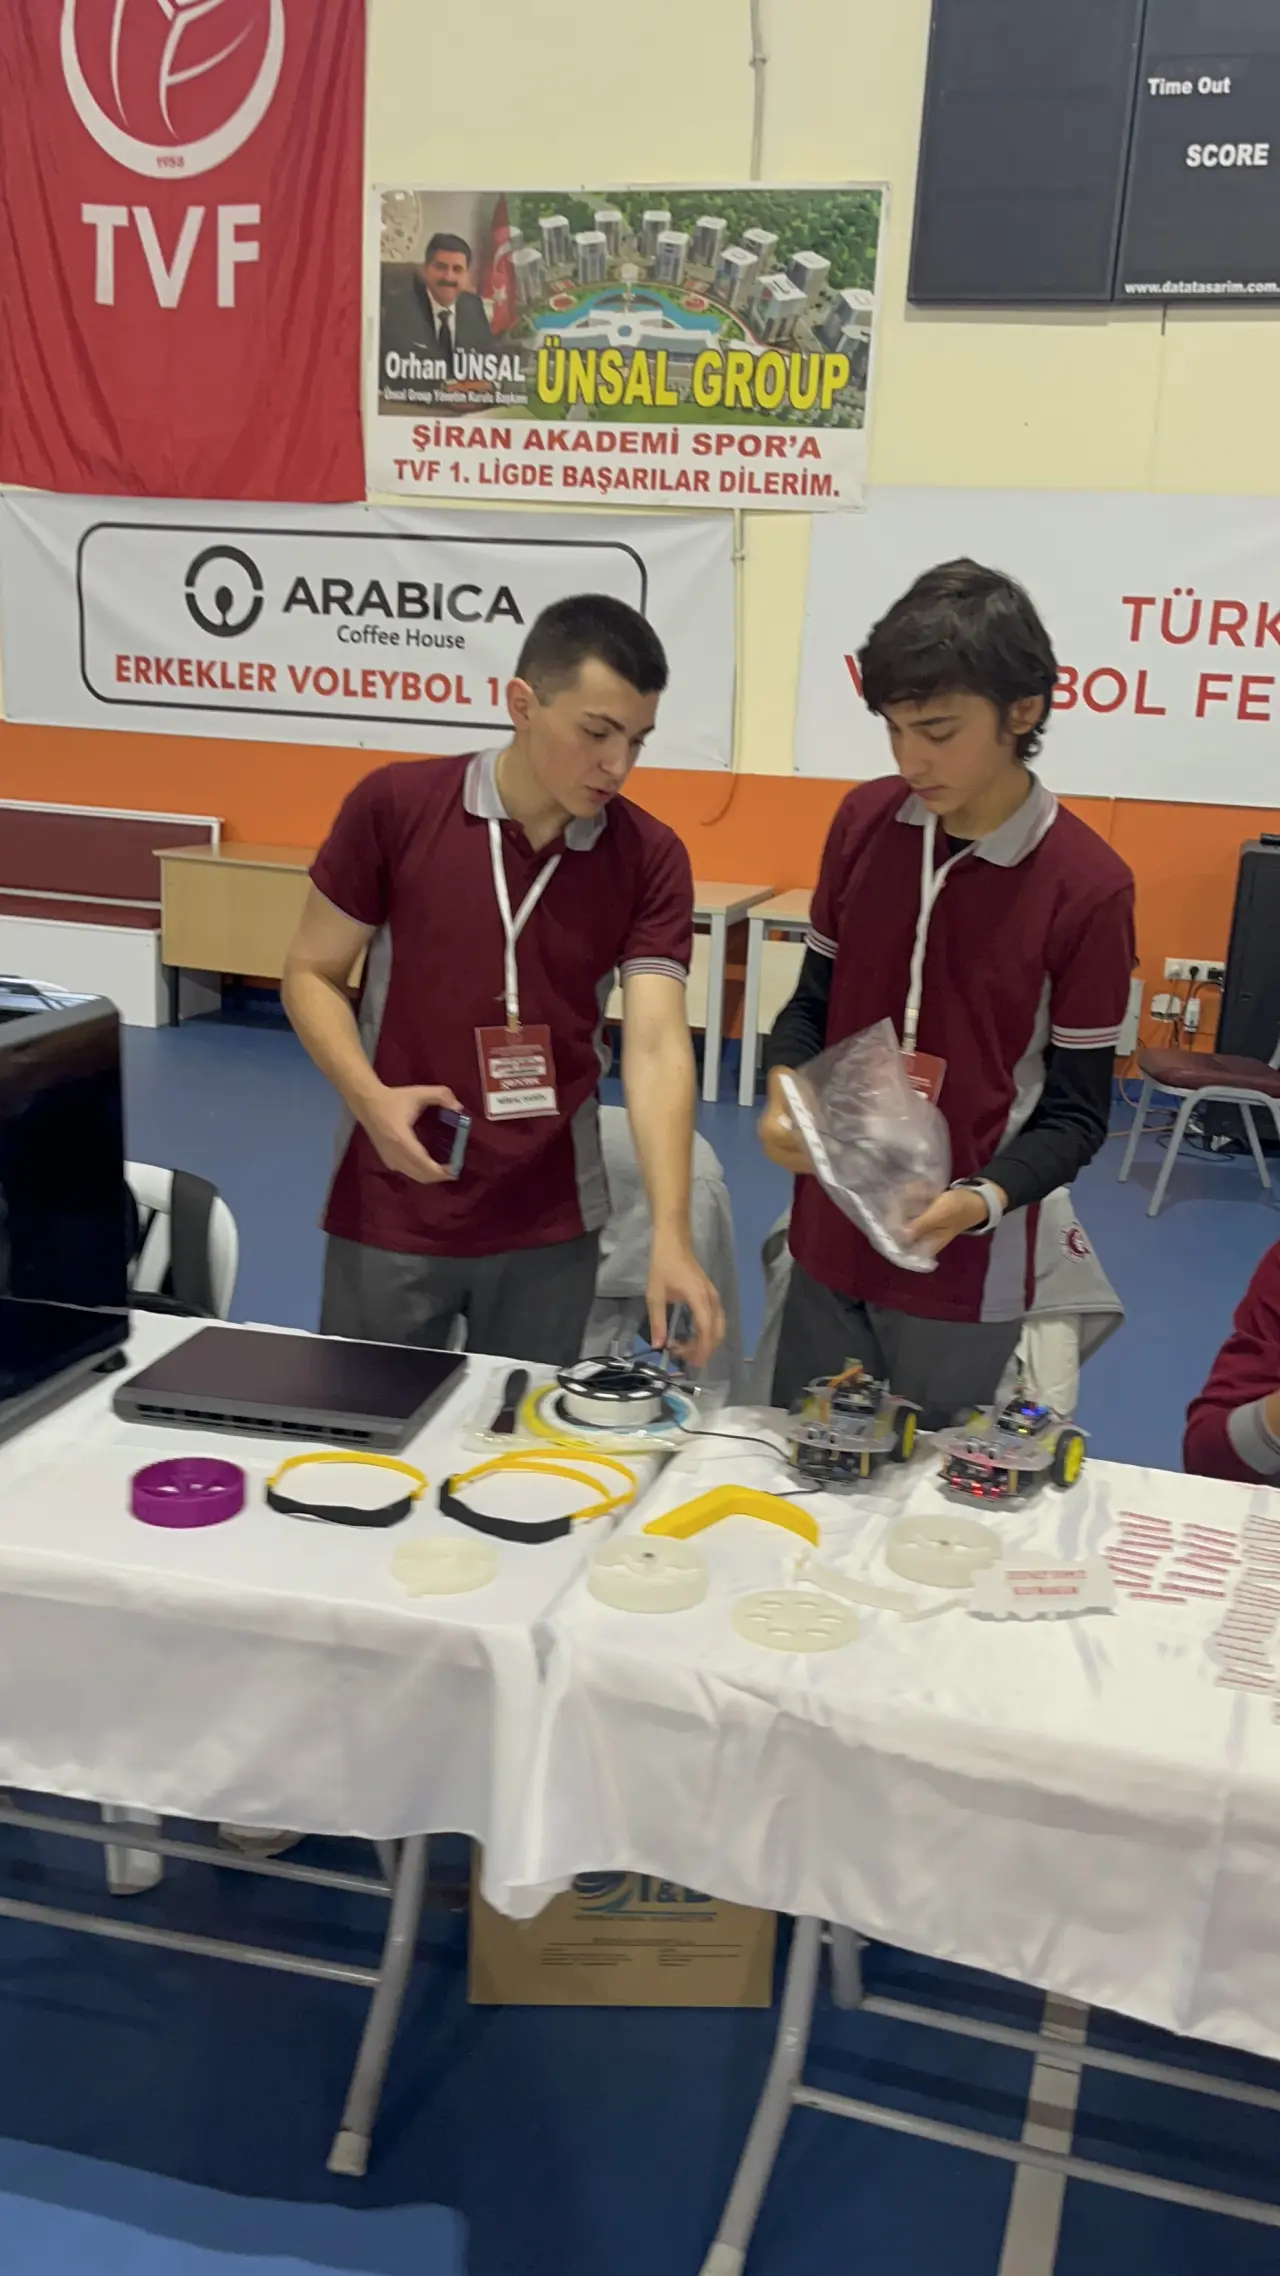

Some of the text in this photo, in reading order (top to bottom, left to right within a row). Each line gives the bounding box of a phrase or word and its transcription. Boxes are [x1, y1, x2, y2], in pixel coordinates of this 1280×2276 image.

[1148, 76, 1232, 95] Time Out
[1186, 143, 1270, 167] SCORE
[81, 203, 261, 308] TVF
[384, 347, 526, 382] Orhan ÜNSAL
[536, 336, 851, 410] ÜNSAL GROUP
[412, 420, 512, 452] ŞİRAN
[523, 427, 679, 455] AKADEMİ
[393, 458, 840, 497] TVF 1. LİGDE BAŞARILAR DİLERİM.
[282, 576, 524, 625] ARABICA
[1122, 587, 1280, 649] TÜRK
[337, 625, 466, 649] Coffee House
[114, 654, 276, 693] ERKEKLER
[288, 664, 472, 705] VOLEYBOL
[1195, 672, 1276, 721] FE
